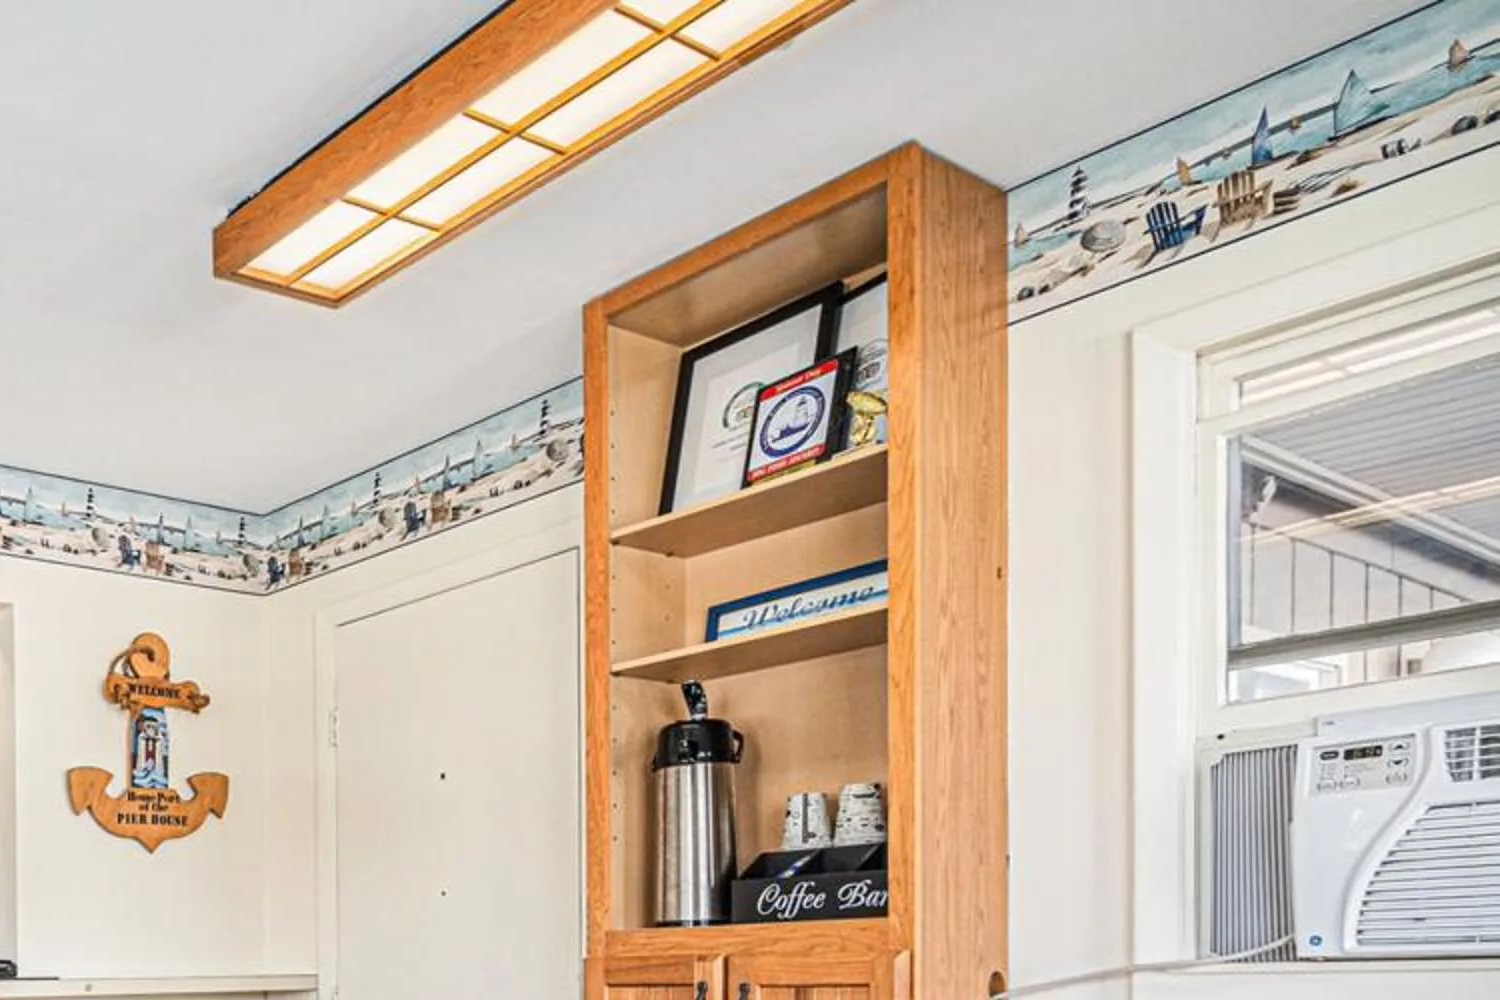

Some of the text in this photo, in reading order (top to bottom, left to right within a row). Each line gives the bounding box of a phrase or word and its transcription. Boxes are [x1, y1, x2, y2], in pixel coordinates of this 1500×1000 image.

[743, 585, 874, 629] Welcome
[117, 813, 189, 827] PIER HOUSE
[756, 879, 889, 919] Coffee Bar
